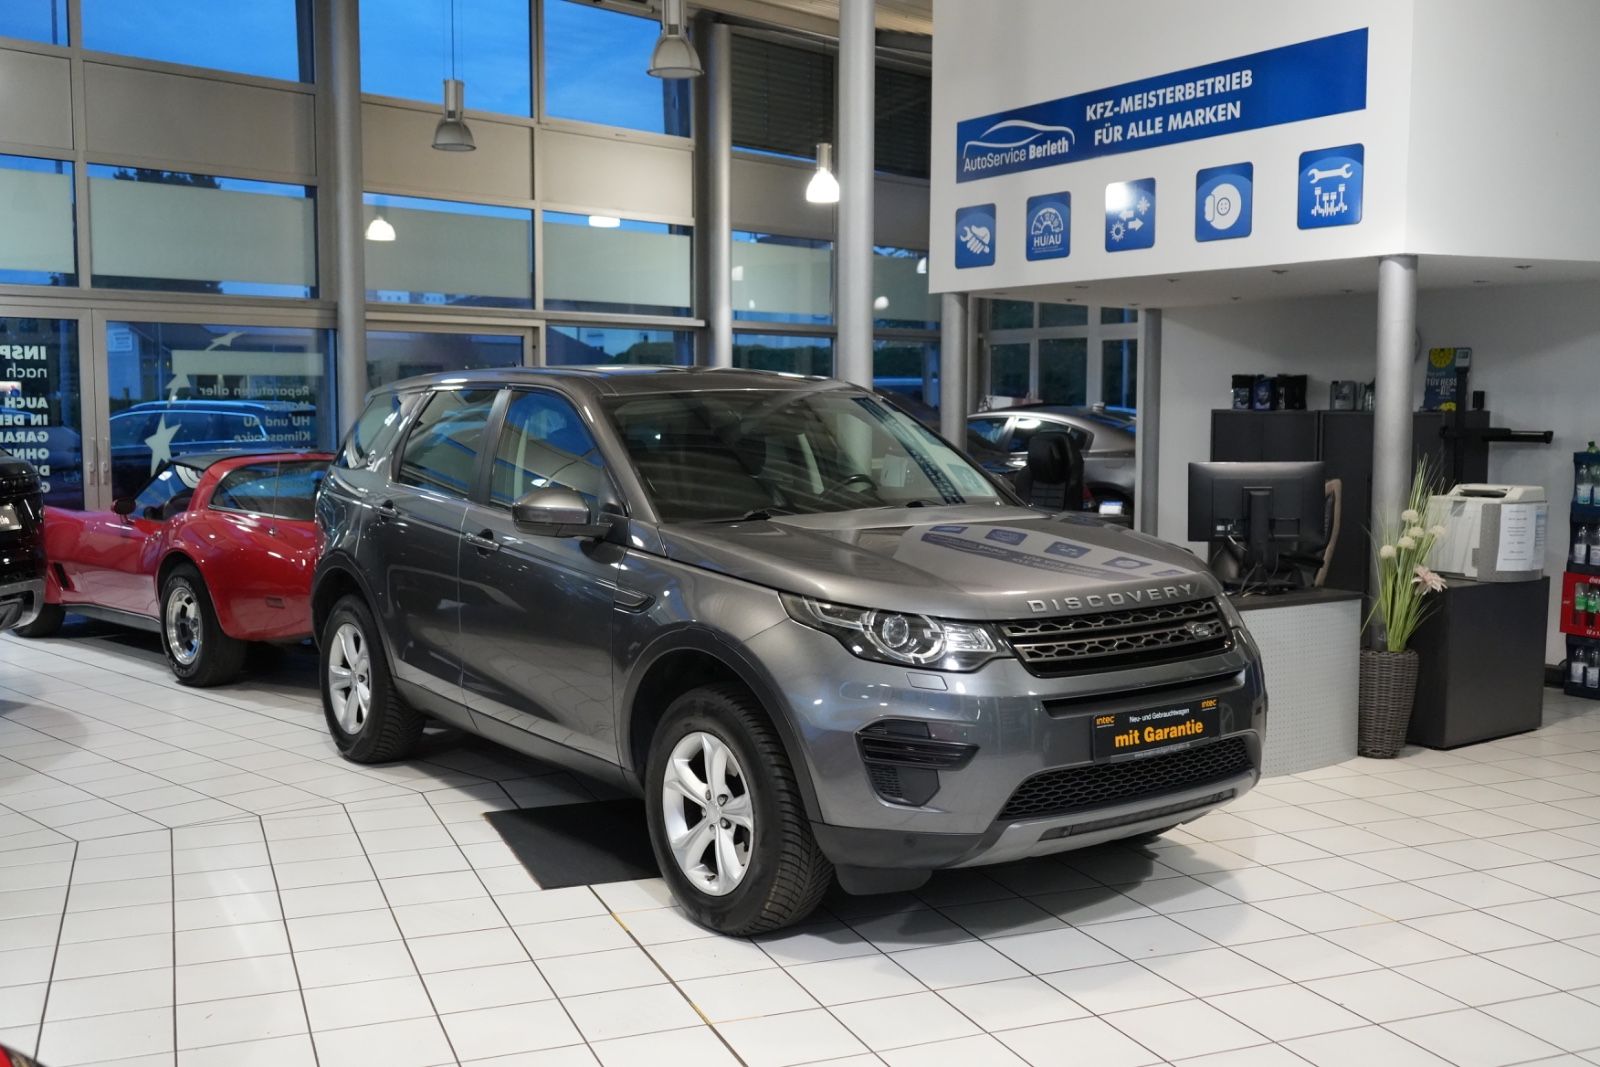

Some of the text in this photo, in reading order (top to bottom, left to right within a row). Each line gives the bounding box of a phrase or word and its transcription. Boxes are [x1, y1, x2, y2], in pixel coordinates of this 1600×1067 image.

[1086, 69, 1253, 122] KFZ-MEISTERBETRIEB
[1094, 100, 1241, 146] FÜR ALLE MARKEN
[963, 136, 1069, 172] AutoService Berleth
[1033, 233, 1062, 247] HU/AU
[1027, 584, 1191, 613] DISCOVERY
[1142, 713, 1152, 721] und
[1152, 708, 1190, 720] Gebrauchtwagen
[1115, 719, 1204, 748] mit Garantie
